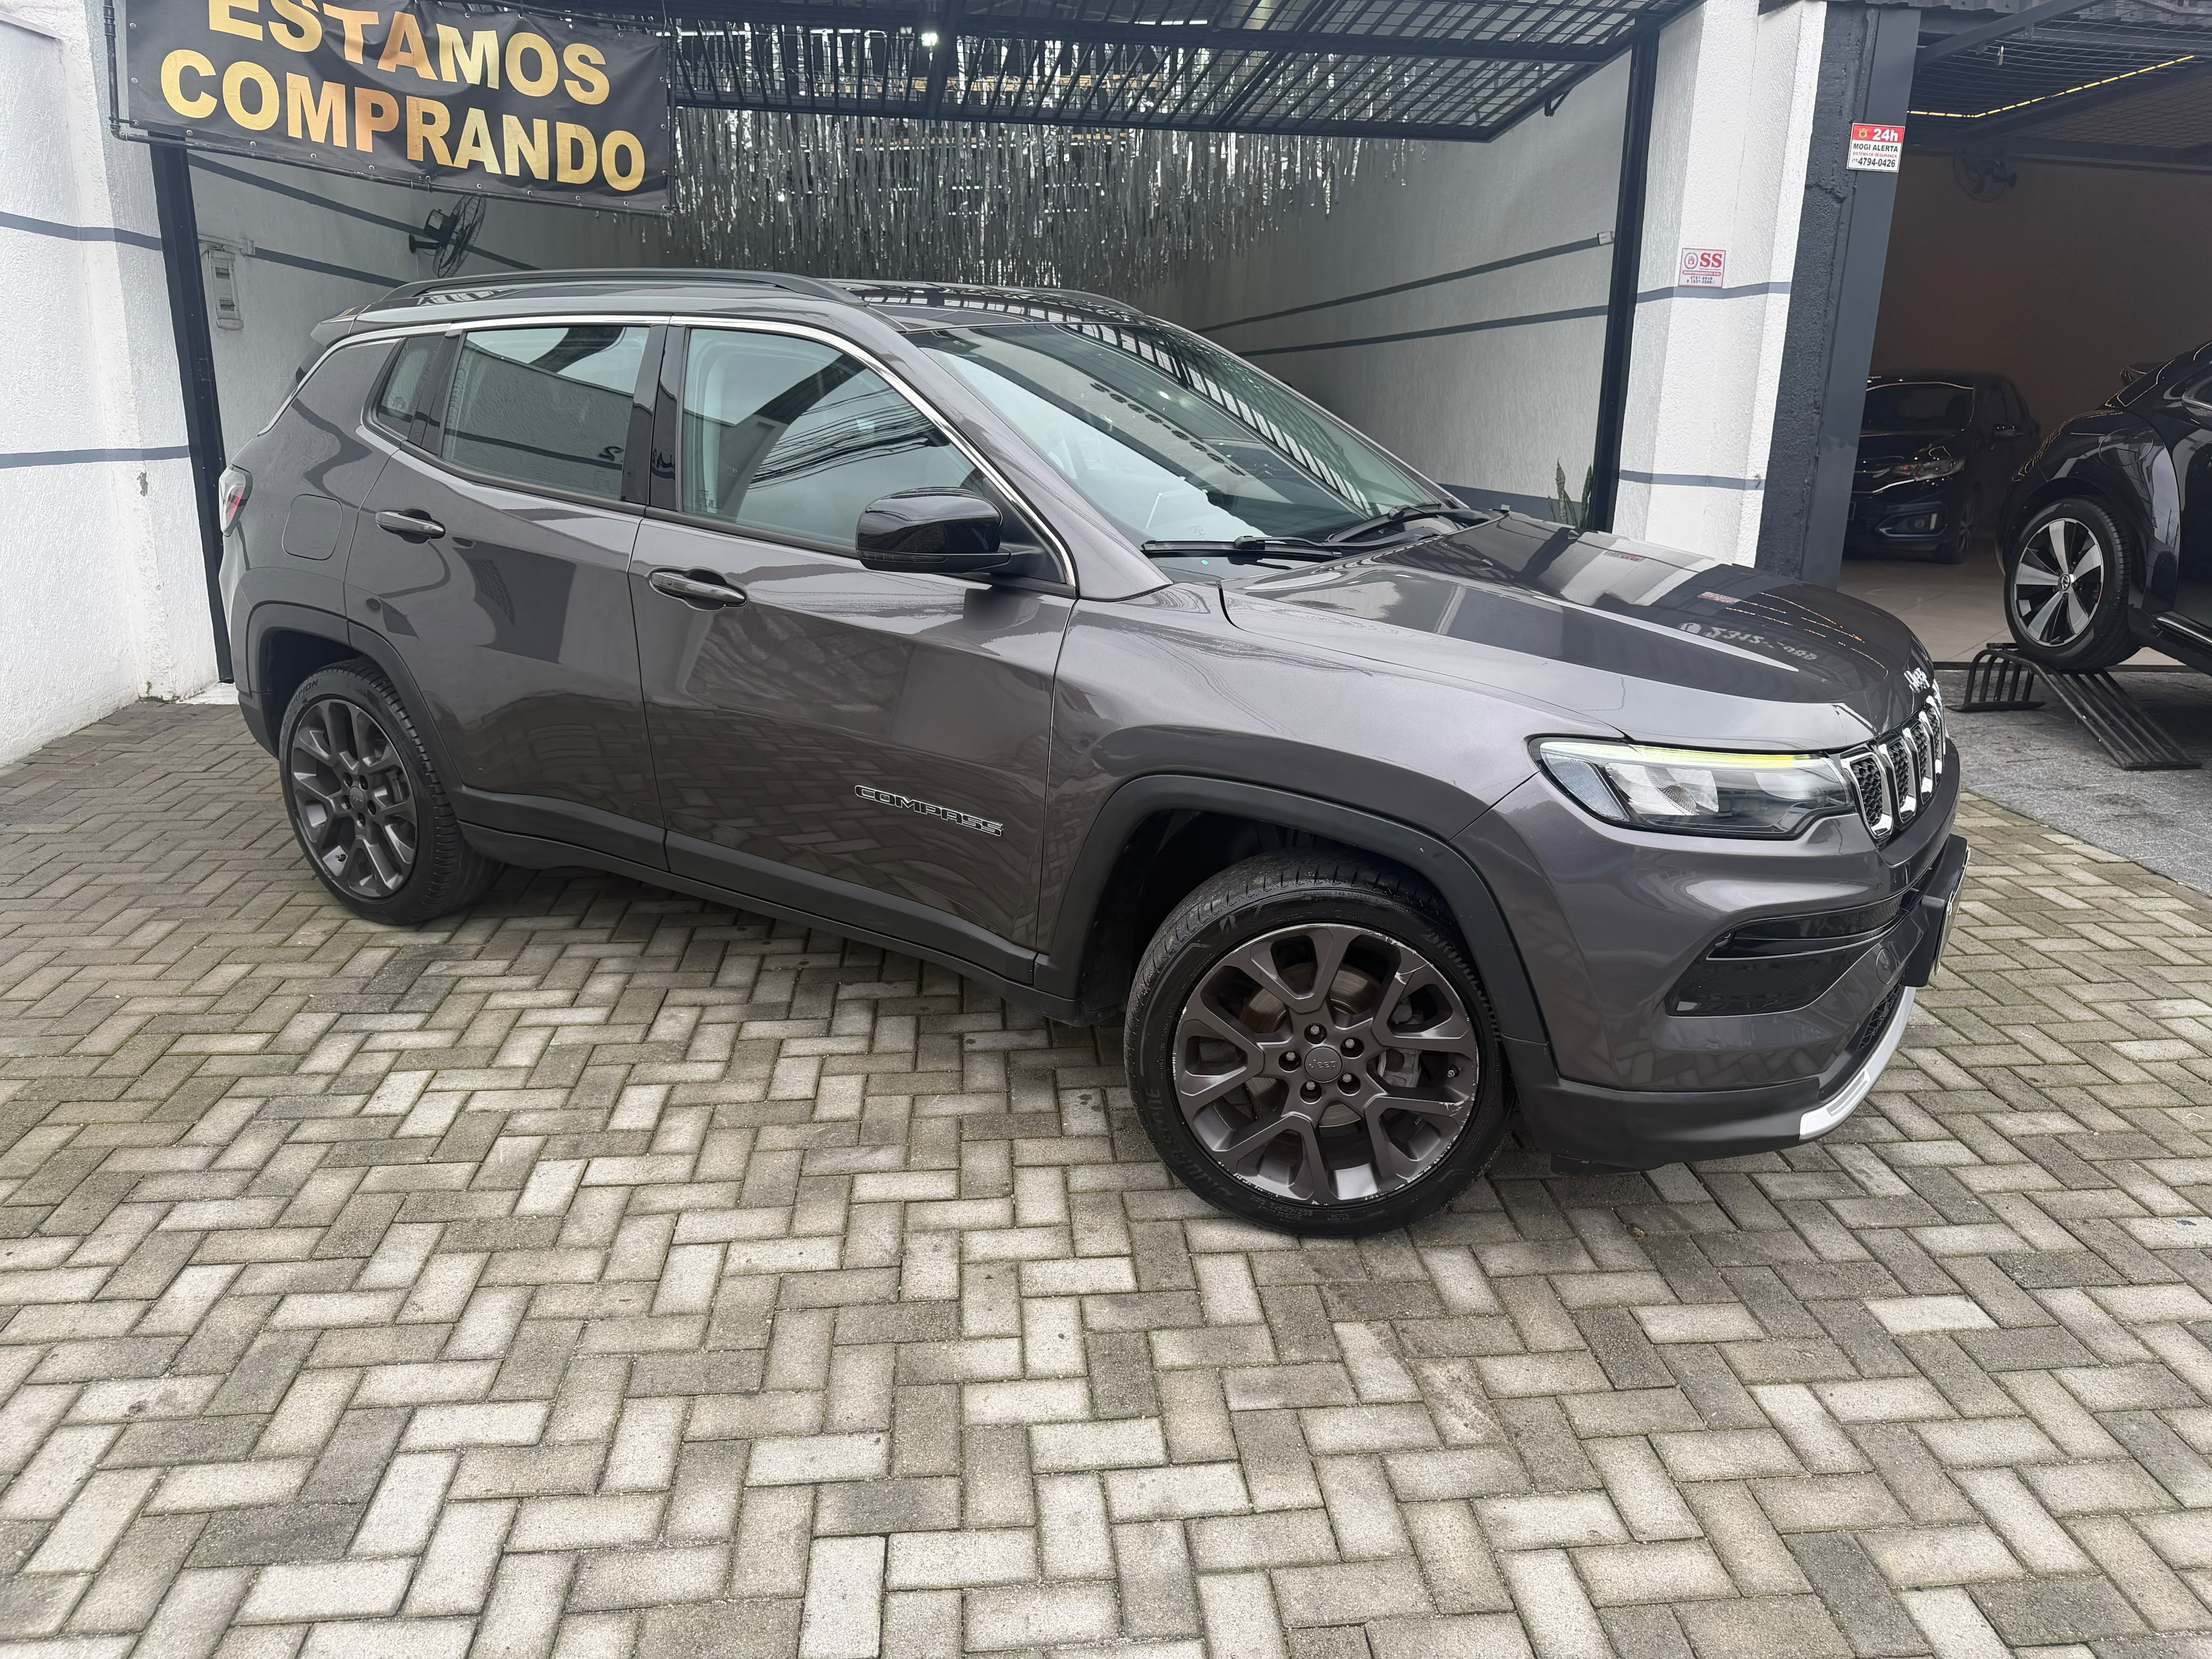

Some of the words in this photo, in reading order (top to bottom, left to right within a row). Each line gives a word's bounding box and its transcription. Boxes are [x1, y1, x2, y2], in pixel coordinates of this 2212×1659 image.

[208, 0, 610, 105] ESTAMOS
[160, 49, 646, 192] COMPRANDO
[1872, 128, 1898, 141] 24h
[1858, 157, 1896, 167] 4794-0426
[1699, 253, 1722, 268] SS
[854, 785, 1003, 837] COMPASS
[1309, 1059, 1337, 1070] Jeep
